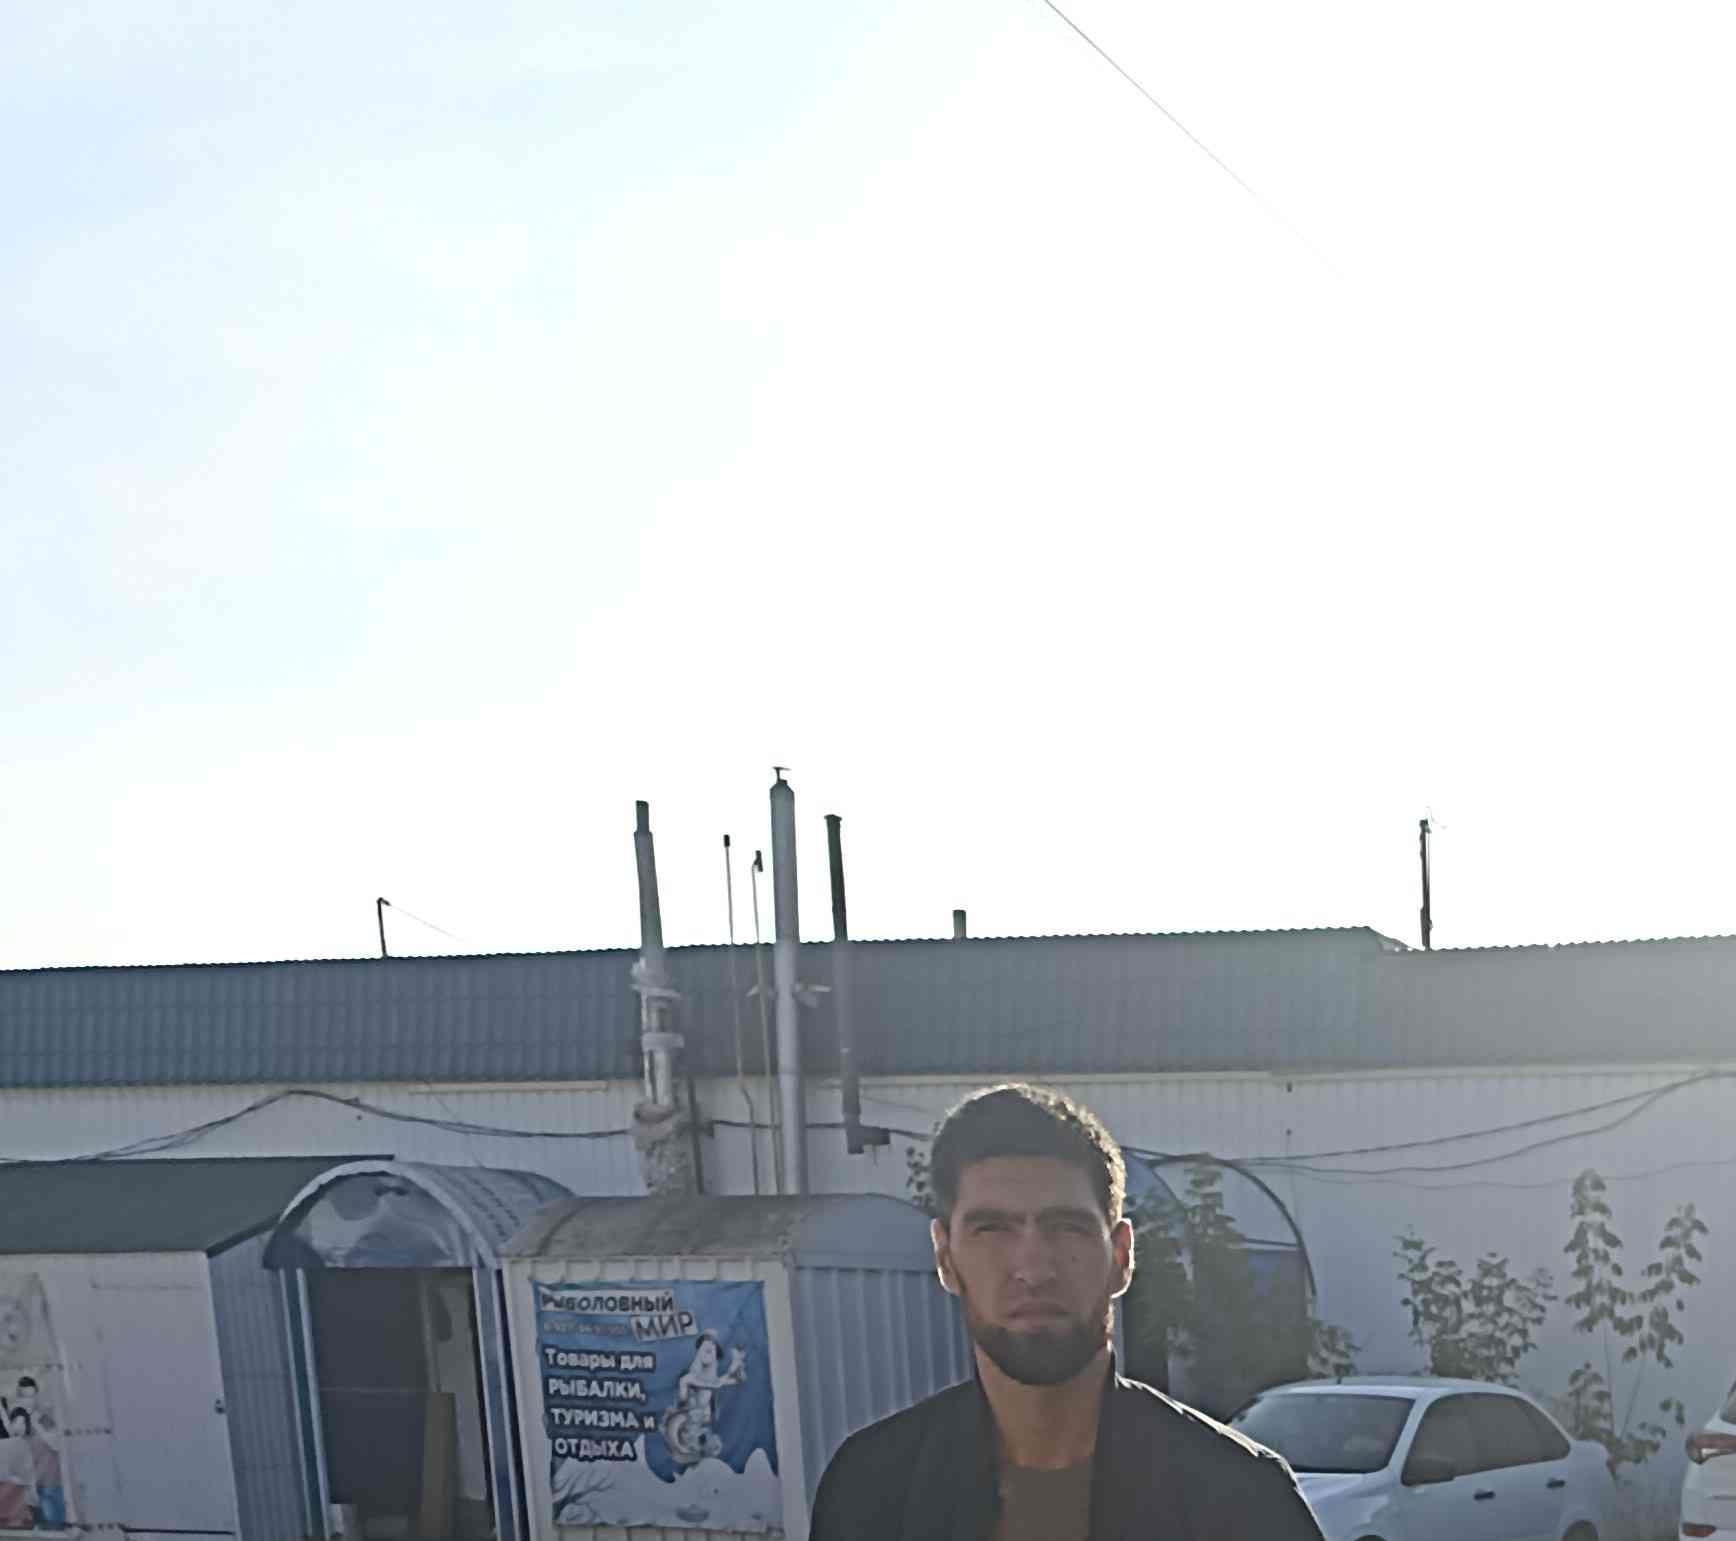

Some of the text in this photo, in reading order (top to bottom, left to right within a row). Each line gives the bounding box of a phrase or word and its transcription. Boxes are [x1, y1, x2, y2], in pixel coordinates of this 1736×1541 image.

[634, 1311, 693, 1338] МИР
[545, 1347, 654, 1370] Товары для
[548, 1377, 646, 1401] РЫБАЛКИ,
[550, 1407, 640, 1430] ТУРИЗМА
[554, 1437, 635, 1458] ОТДЫХА
